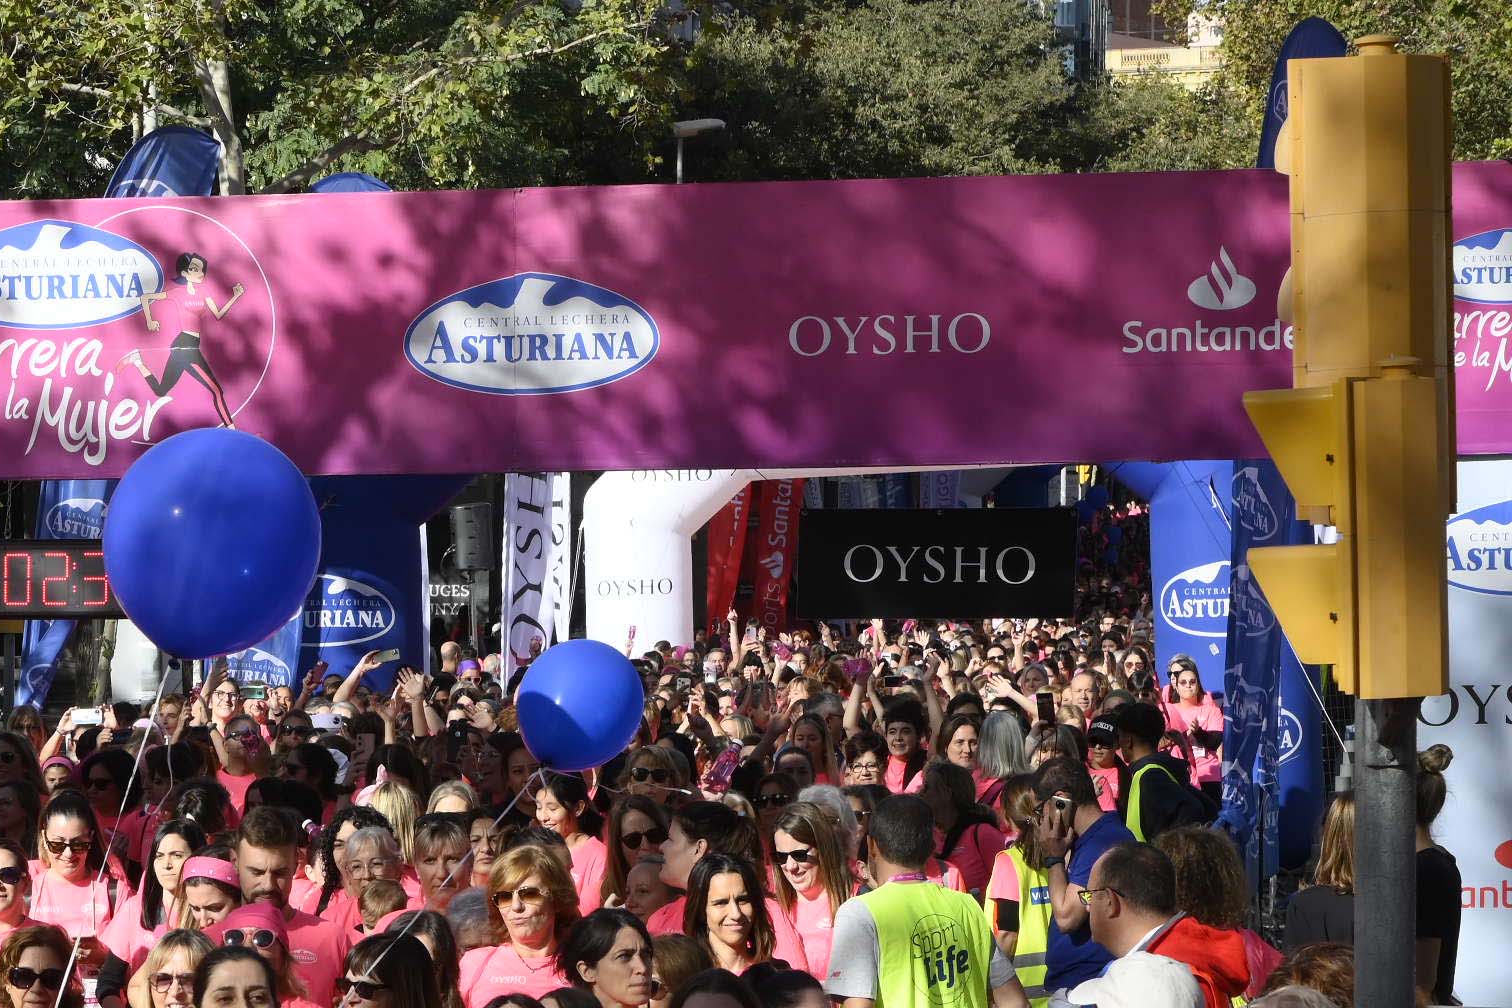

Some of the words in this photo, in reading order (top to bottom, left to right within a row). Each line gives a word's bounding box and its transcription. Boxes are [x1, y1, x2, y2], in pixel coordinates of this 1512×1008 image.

[65, 256, 138, 268] LECHERA
[464, 315, 542, 329] CENTRAL
[549, 312, 631, 327] LECHERA
[788, 312, 992, 357] OYSHO
[424, 319, 639, 365] ASTURIANA
[1472, 338, 1490, 367] la
[5, 382, 29, 420] la
[25, 371, 174, 465] Mujer
[843, 543, 1036, 584] OYSHO
[597, 576, 674, 598] OYSHO
[912, 921, 958, 959] Sport
[923, 945, 969, 990] Life
